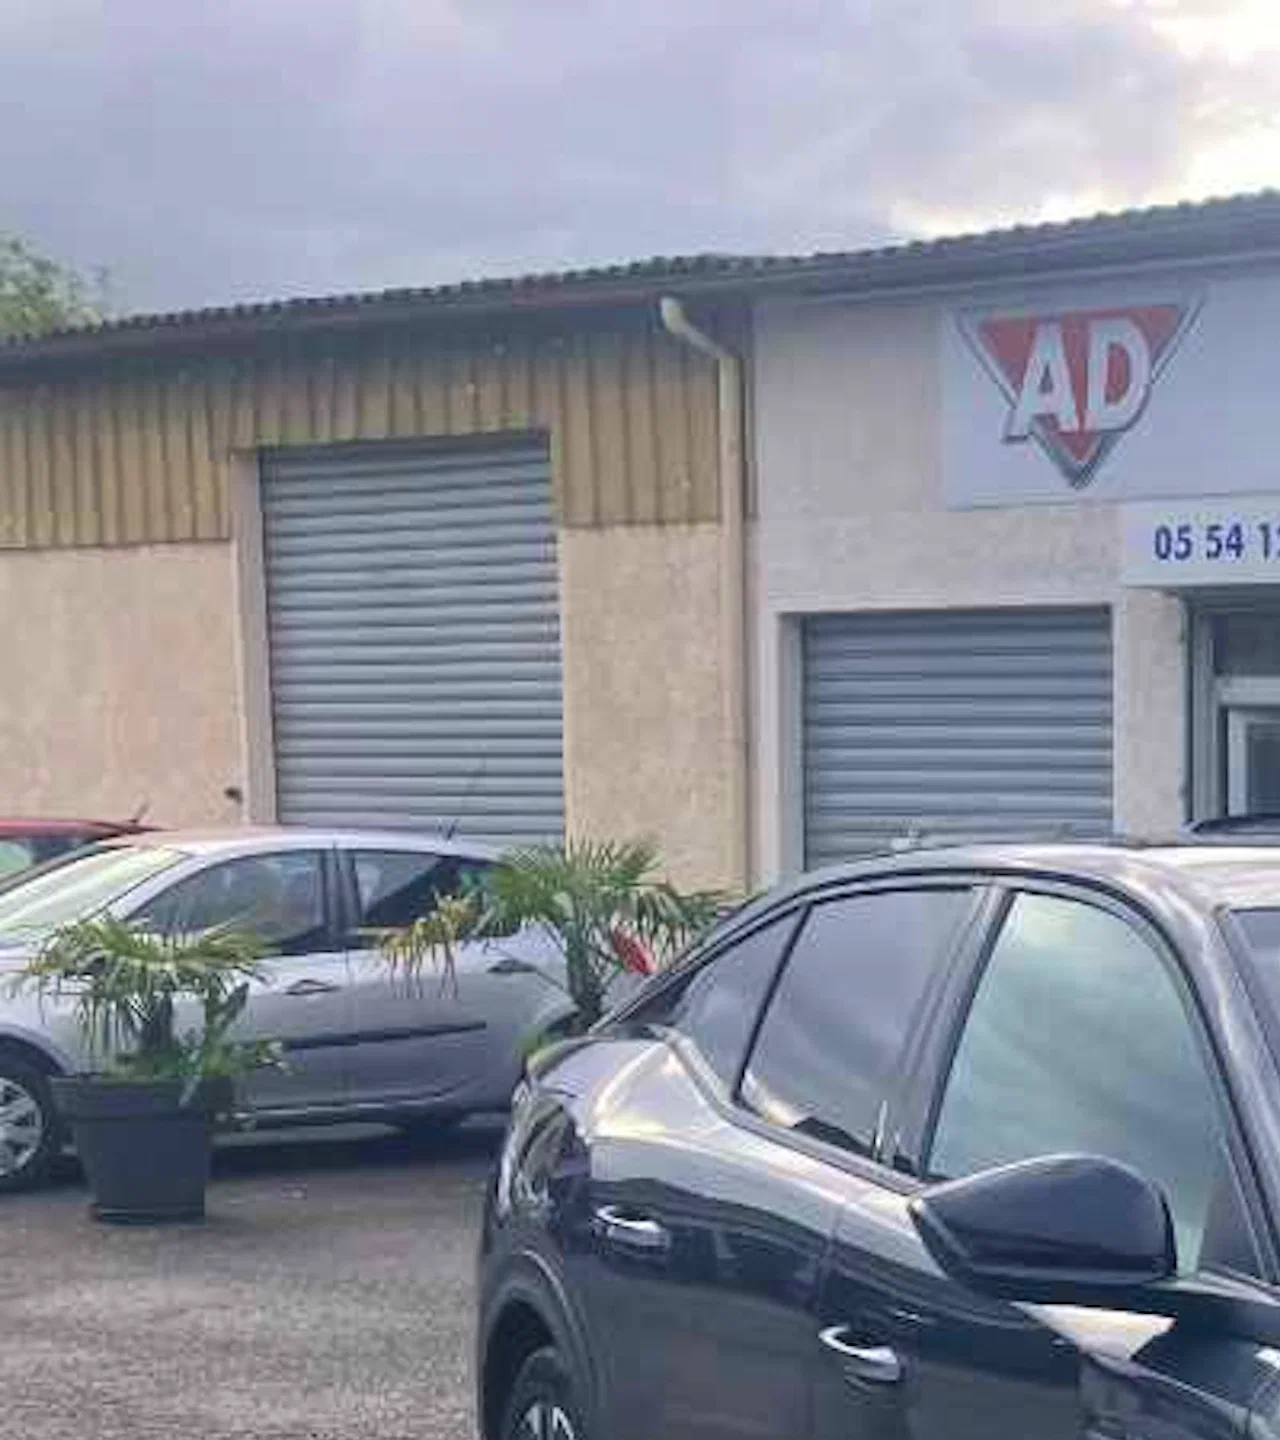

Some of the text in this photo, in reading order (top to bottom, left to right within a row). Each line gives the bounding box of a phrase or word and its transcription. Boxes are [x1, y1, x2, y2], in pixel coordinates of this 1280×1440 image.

[1001, 318, 1151, 440] AD
[1154, 524, 1193, 561] 05
[1206, 524, 1245, 560] 54
